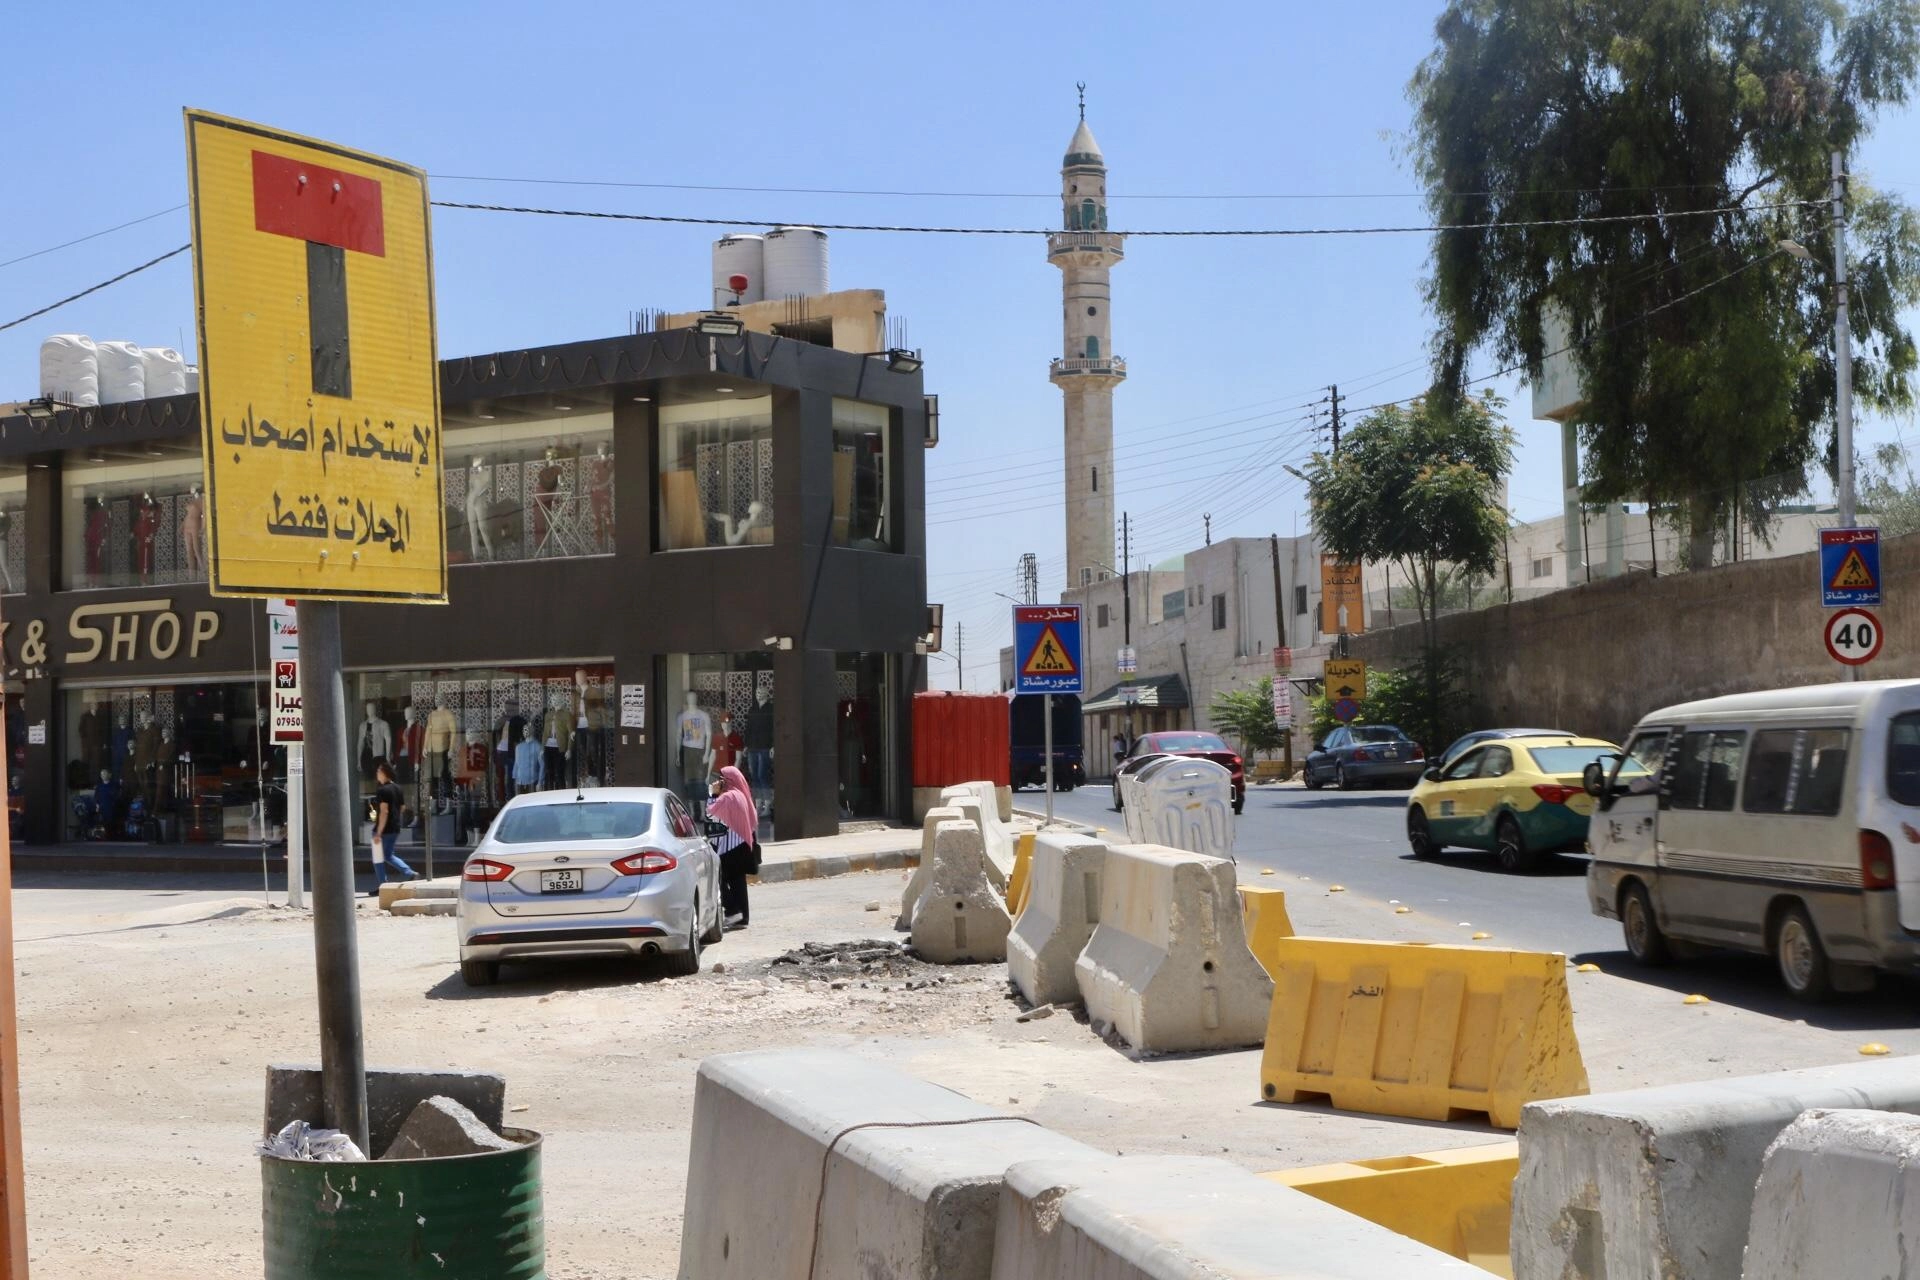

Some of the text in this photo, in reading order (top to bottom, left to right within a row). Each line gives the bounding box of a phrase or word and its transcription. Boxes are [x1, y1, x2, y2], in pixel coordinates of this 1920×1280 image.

[222, 398, 315, 464] أصحاب
[267, 490, 410, 553] المحلات فقط
[1825, 590, 1880, 601] عبور مشاة
[21, 619, 47, 665] &
[1835, 623, 1872, 649] 40
[1327, 663, 1361, 679] تحويلة
[1022, 676, 1079, 688] عبور مشاة
[559, 871, 571, 880] 23
[549, 880, 579, 890] 96921
